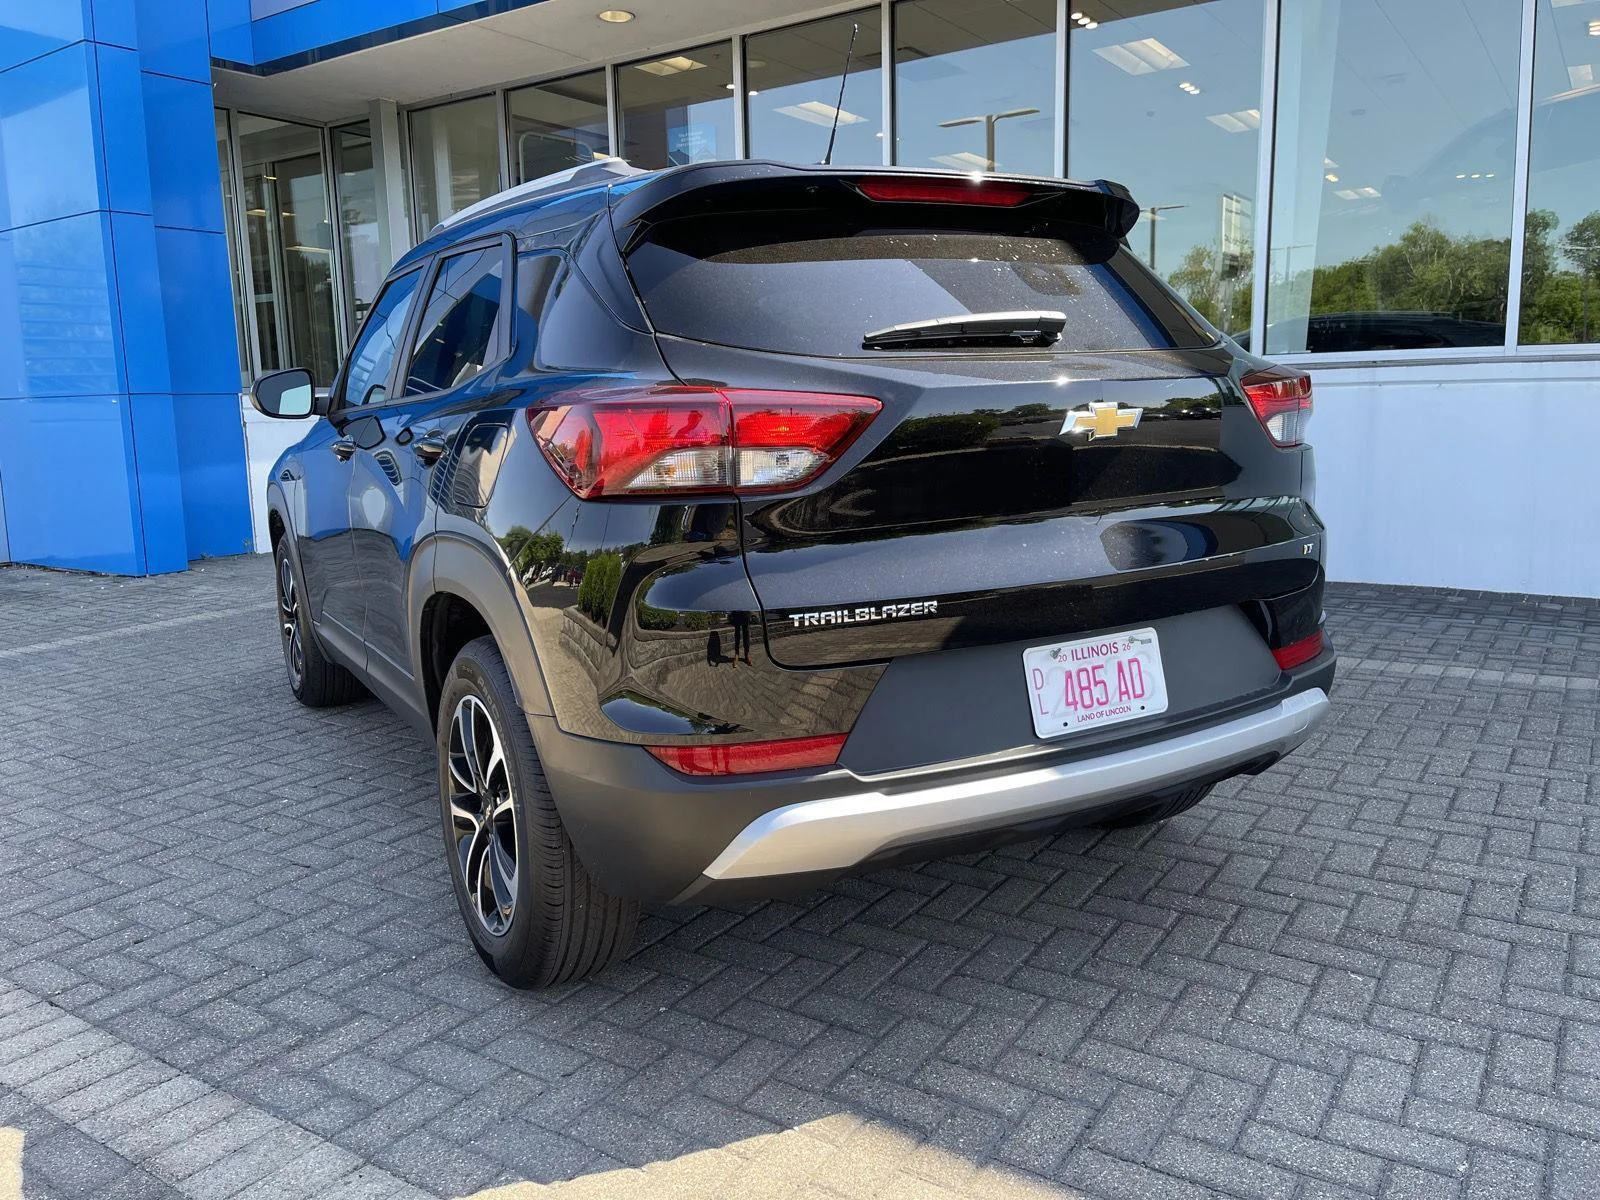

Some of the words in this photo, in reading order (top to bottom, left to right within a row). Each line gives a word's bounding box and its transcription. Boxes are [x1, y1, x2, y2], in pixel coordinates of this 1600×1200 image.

[788, 600, 938, 627] TRAILBLAZER
[1057, 653, 1068, 663] 20
[1071, 641, 1119, 662] ILLINOIS
[1122, 643, 1131, 652] 26
[1064, 664, 1109, 712] 485
[1117, 657, 1145, 702] AD
[1077, 713, 1095, 723] LAND
[1095, 710, 1105, 719] OF
[1105, 705, 1132, 717] LINCOLN
